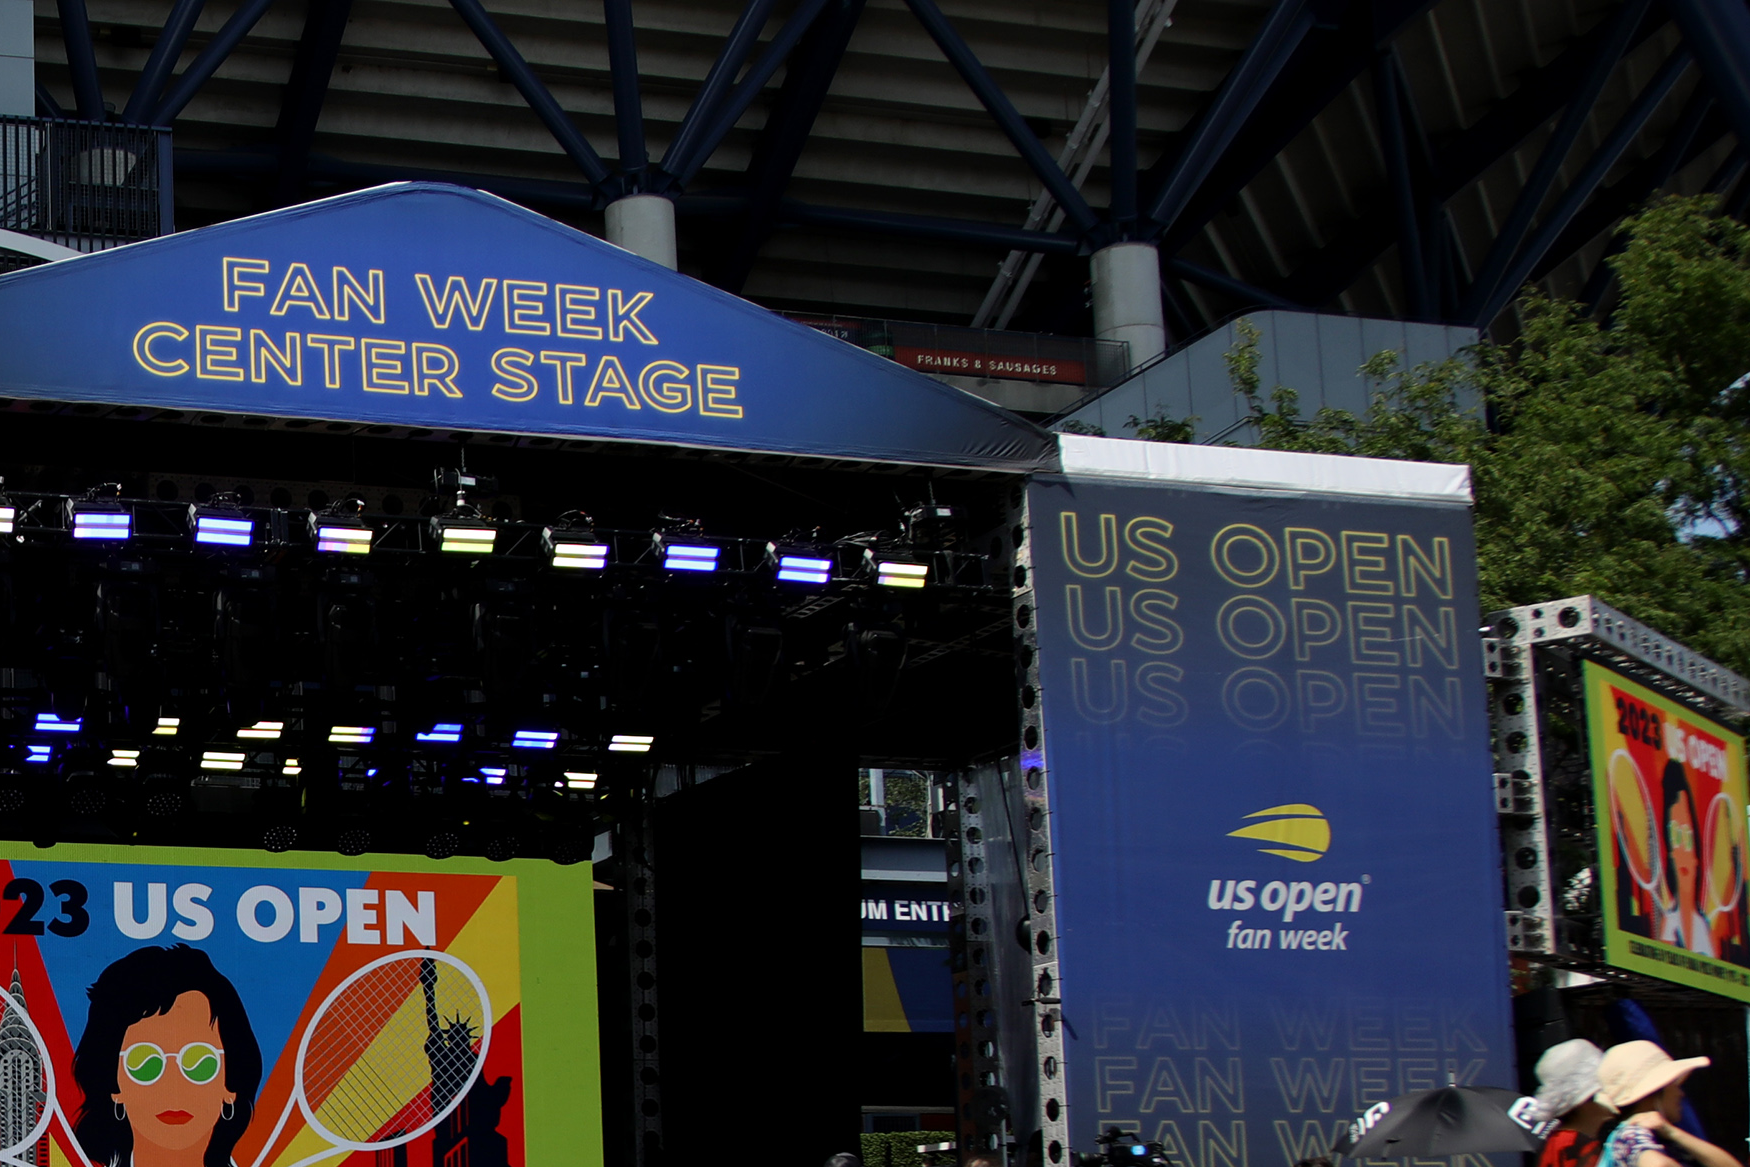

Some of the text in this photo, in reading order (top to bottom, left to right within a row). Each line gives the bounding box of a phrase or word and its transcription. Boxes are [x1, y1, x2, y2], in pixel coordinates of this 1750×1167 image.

[222, 256, 659, 345] FAN WEEK
[132, 321, 744, 419] CENTER STAGE
[917, 354, 1057, 376] FRANKS & SAUSAGES
[1060, 512, 1453, 599] US OPEN
[1065, 585, 1460, 669] US OPEN
[1070, 658, 1465, 740] US OPEN
[1617, 697, 1662, 750] 2023
[113, 881, 215, 941] US
[236, 884, 437, 946] OPEN
[1208, 879, 1363, 922] us open
[1226, 920, 1349, 950] fan week
[1092, 998, 1489, 1051] FAN WEEK
[1095, 1056, 1244, 1113] FAN
